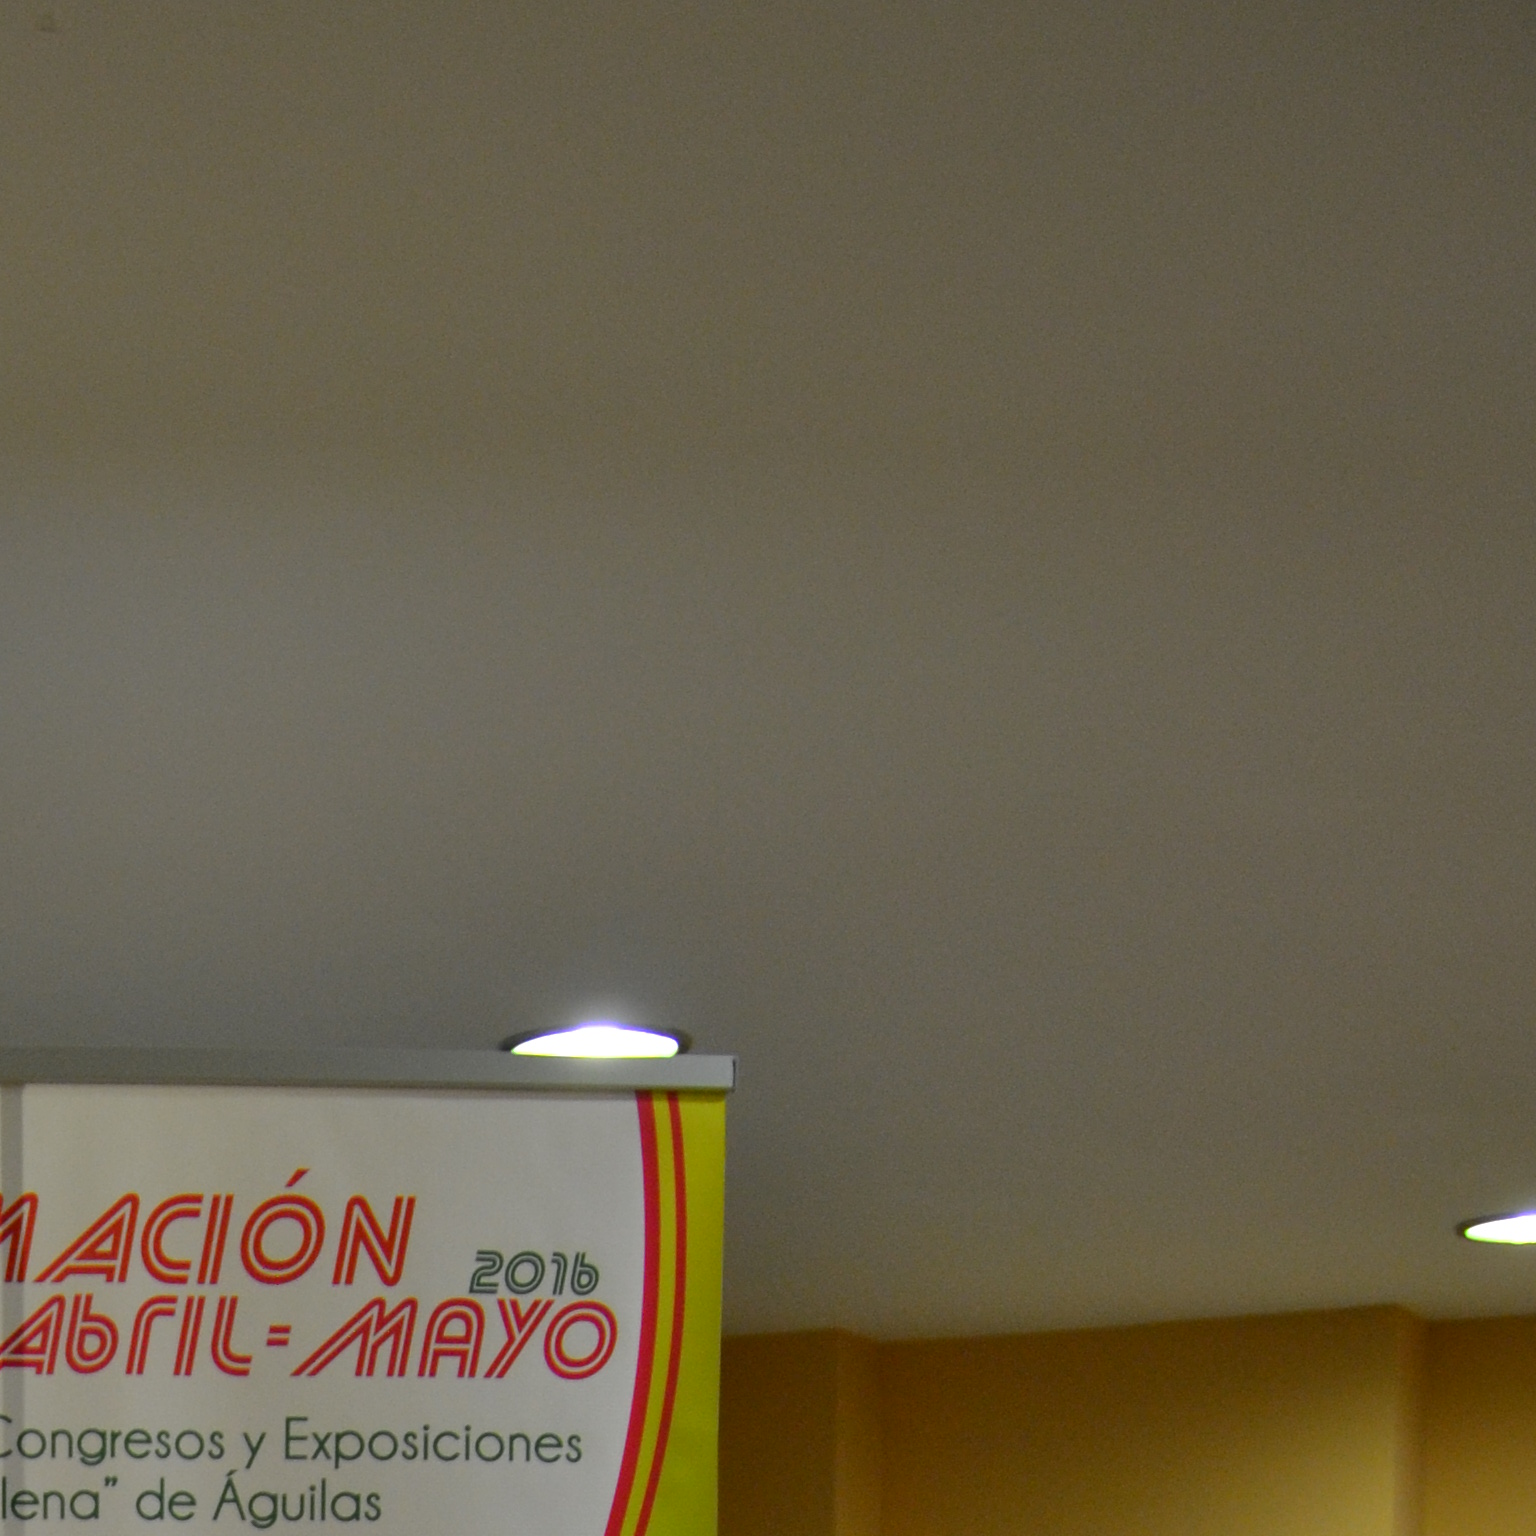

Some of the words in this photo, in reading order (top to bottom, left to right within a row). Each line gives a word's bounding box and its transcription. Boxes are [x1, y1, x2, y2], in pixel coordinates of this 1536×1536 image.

[469, 1250, 599, 1295] 2016
[243, 1432, 266, 1469] y
[285, 1416, 582, 1469] Exposiciones
[136, 1477, 196, 1521] de
[213, 1471, 381, 1529] Águilas
